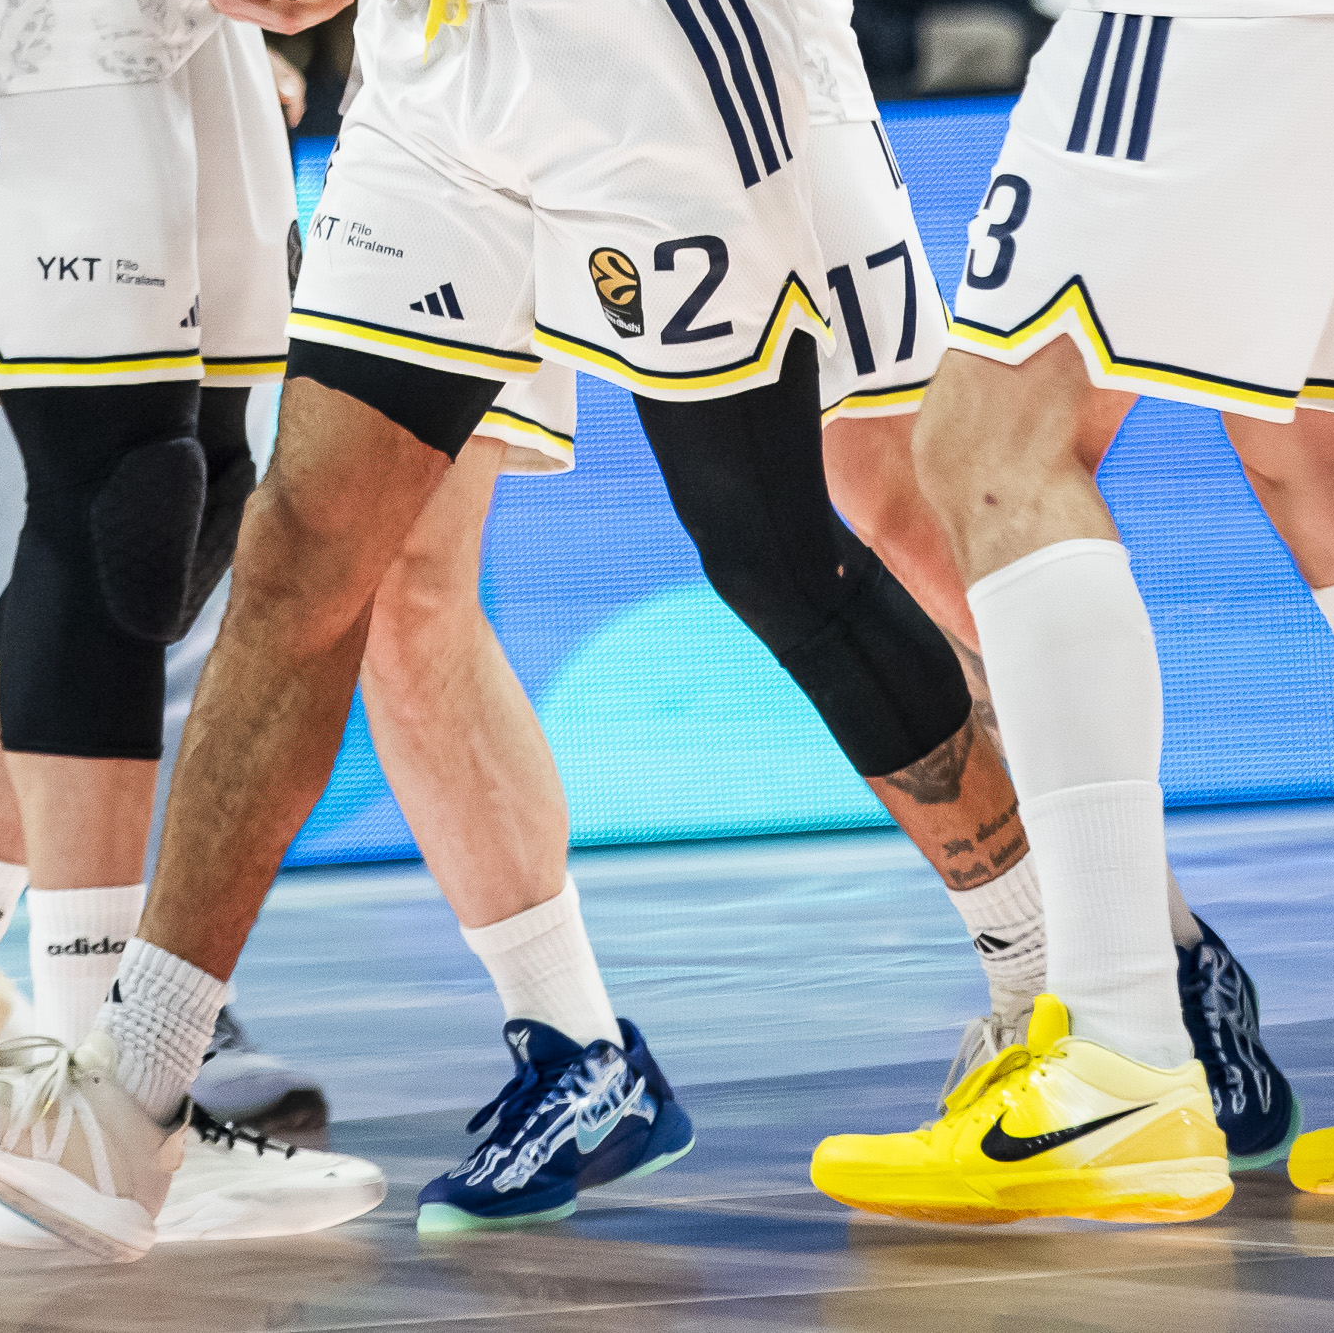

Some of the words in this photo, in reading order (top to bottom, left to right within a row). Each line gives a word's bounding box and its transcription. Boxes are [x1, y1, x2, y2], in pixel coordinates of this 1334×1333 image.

[350, 222, 372, 236] Filo
[346, 235, 404, 258] Kiralama
[37, 256, 102, 282] YKT
[653, 234, 734, 346] 2
[826, 239, 918, 377] 17
[47, 935, 127, 957] adida
